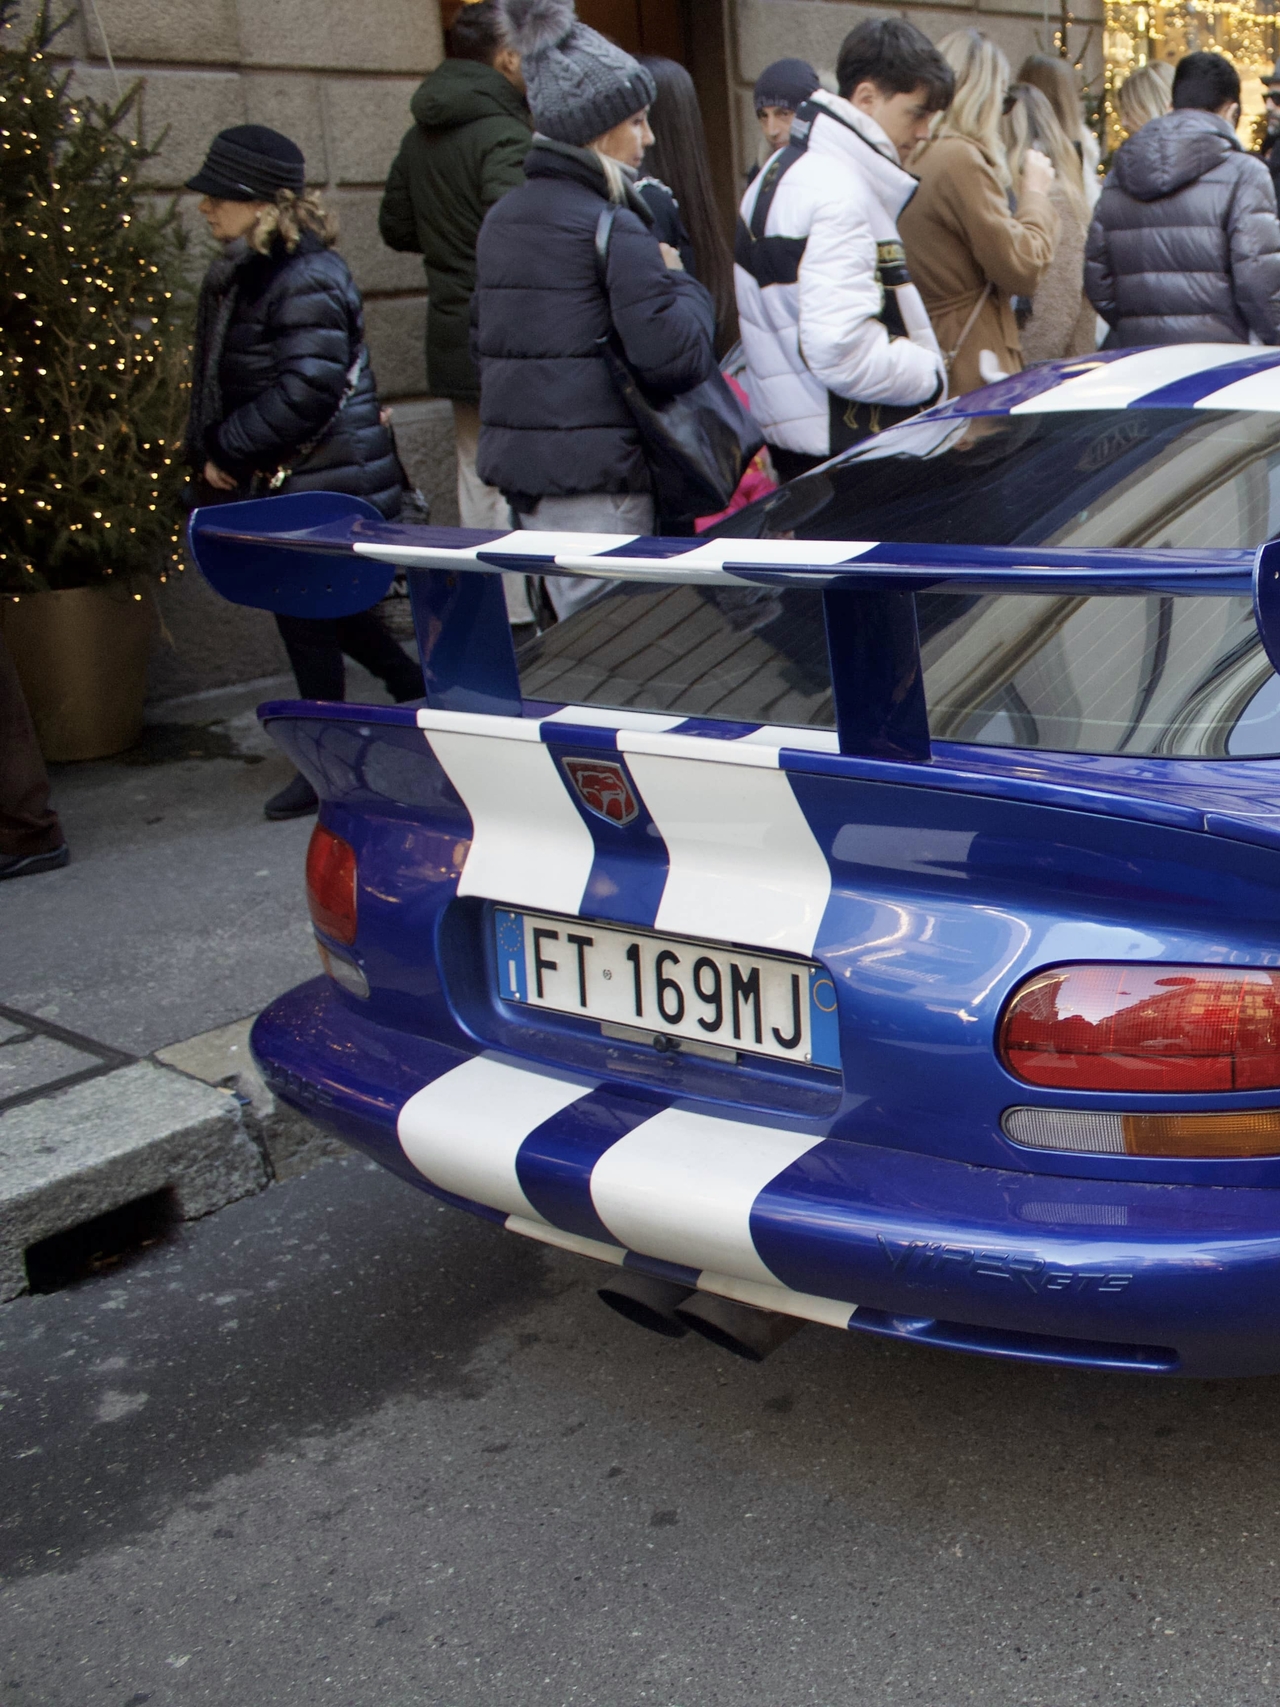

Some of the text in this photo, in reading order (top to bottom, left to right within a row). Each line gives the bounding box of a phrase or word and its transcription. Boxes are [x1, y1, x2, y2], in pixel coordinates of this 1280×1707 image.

[532, 926, 803, 1050] FT 169MJ
[1041, 1271, 1134, 1293] GTS
